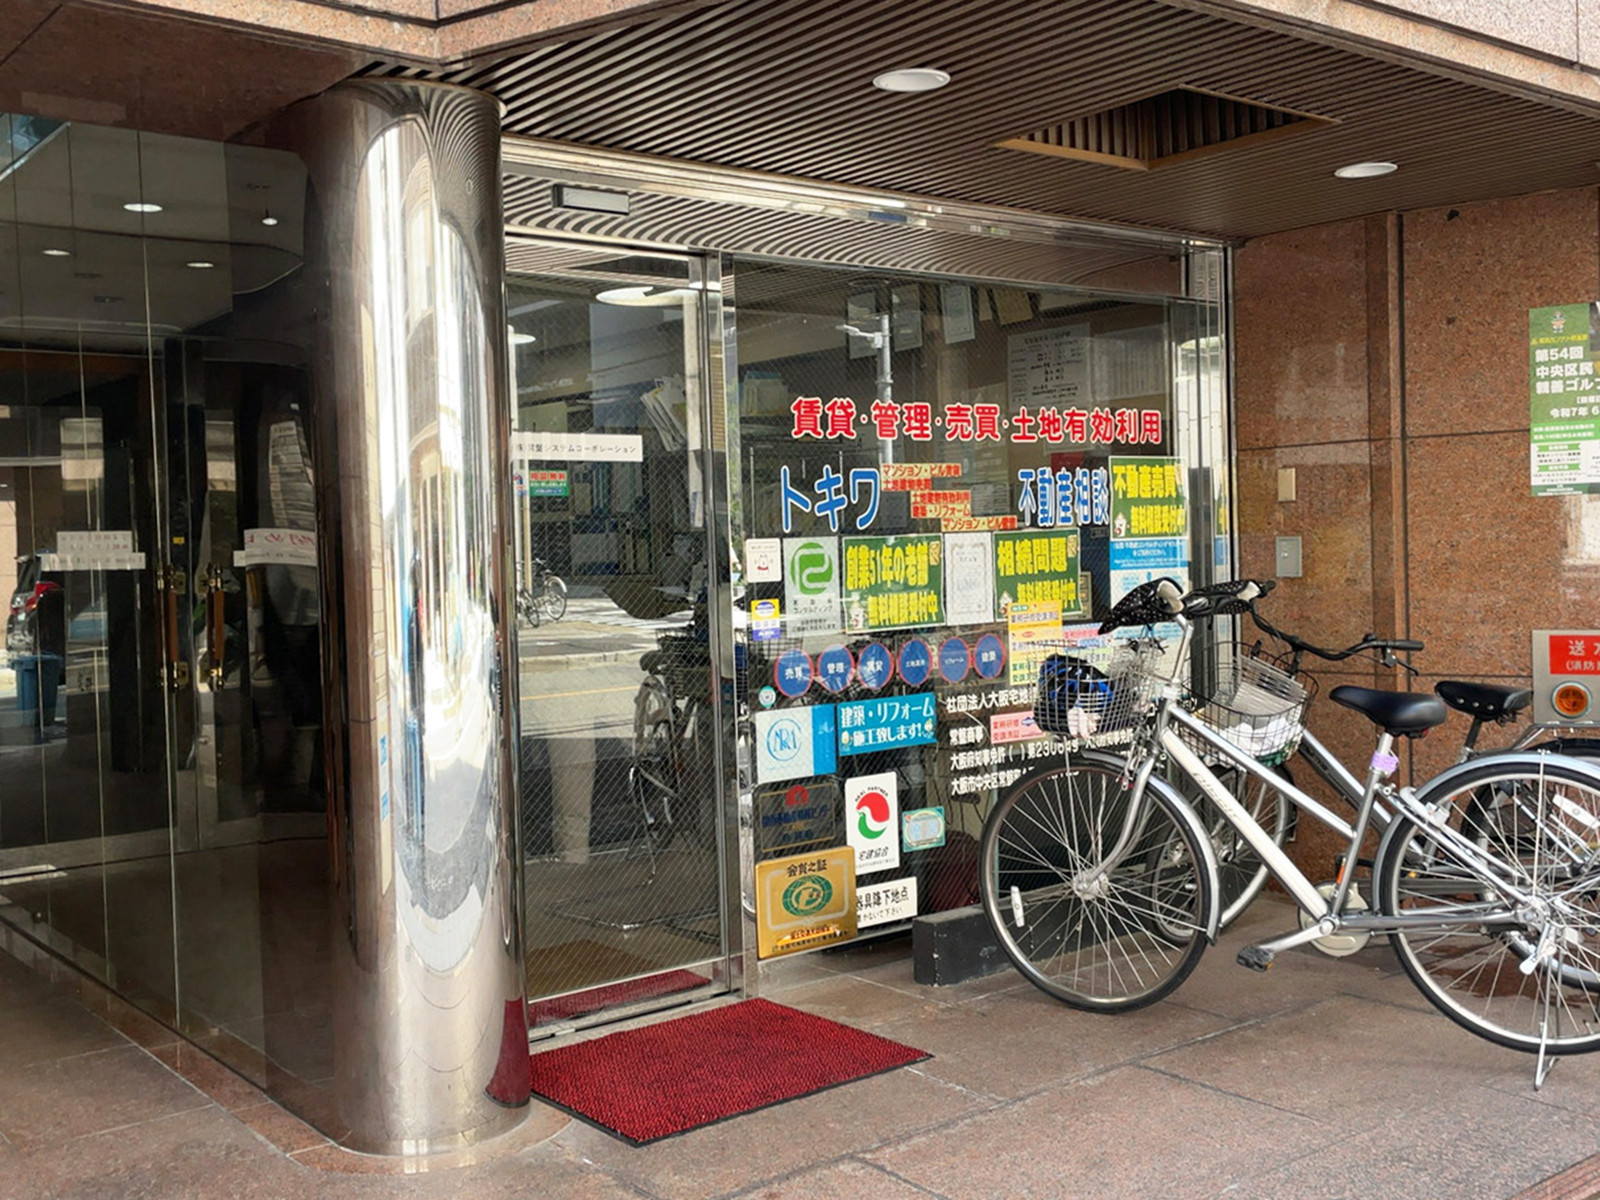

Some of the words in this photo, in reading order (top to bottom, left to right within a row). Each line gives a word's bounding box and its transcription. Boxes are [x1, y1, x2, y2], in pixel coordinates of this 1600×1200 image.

[1535, 346, 1584, 362] 第54回
[1536, 361, 1594, 379] 中央区民
[790, 397, 1163, 446] 賃貸・管理・売買・土地有効利用
[780, 464, 880, 533] トキワ
[1018, 466, 1111, 528] 不動産相談
[1112, 464, 1177, 499] 不動産売買
[846, 541, 929, 591] 創業51年の老舗
[997, 536, 1068, 577] 相続問題
[1565, 659, 1600, 671] (消防
[841, 697, 934, 728] 建築・リフォーム
[852, 722, 922, 748] 施工致します!
